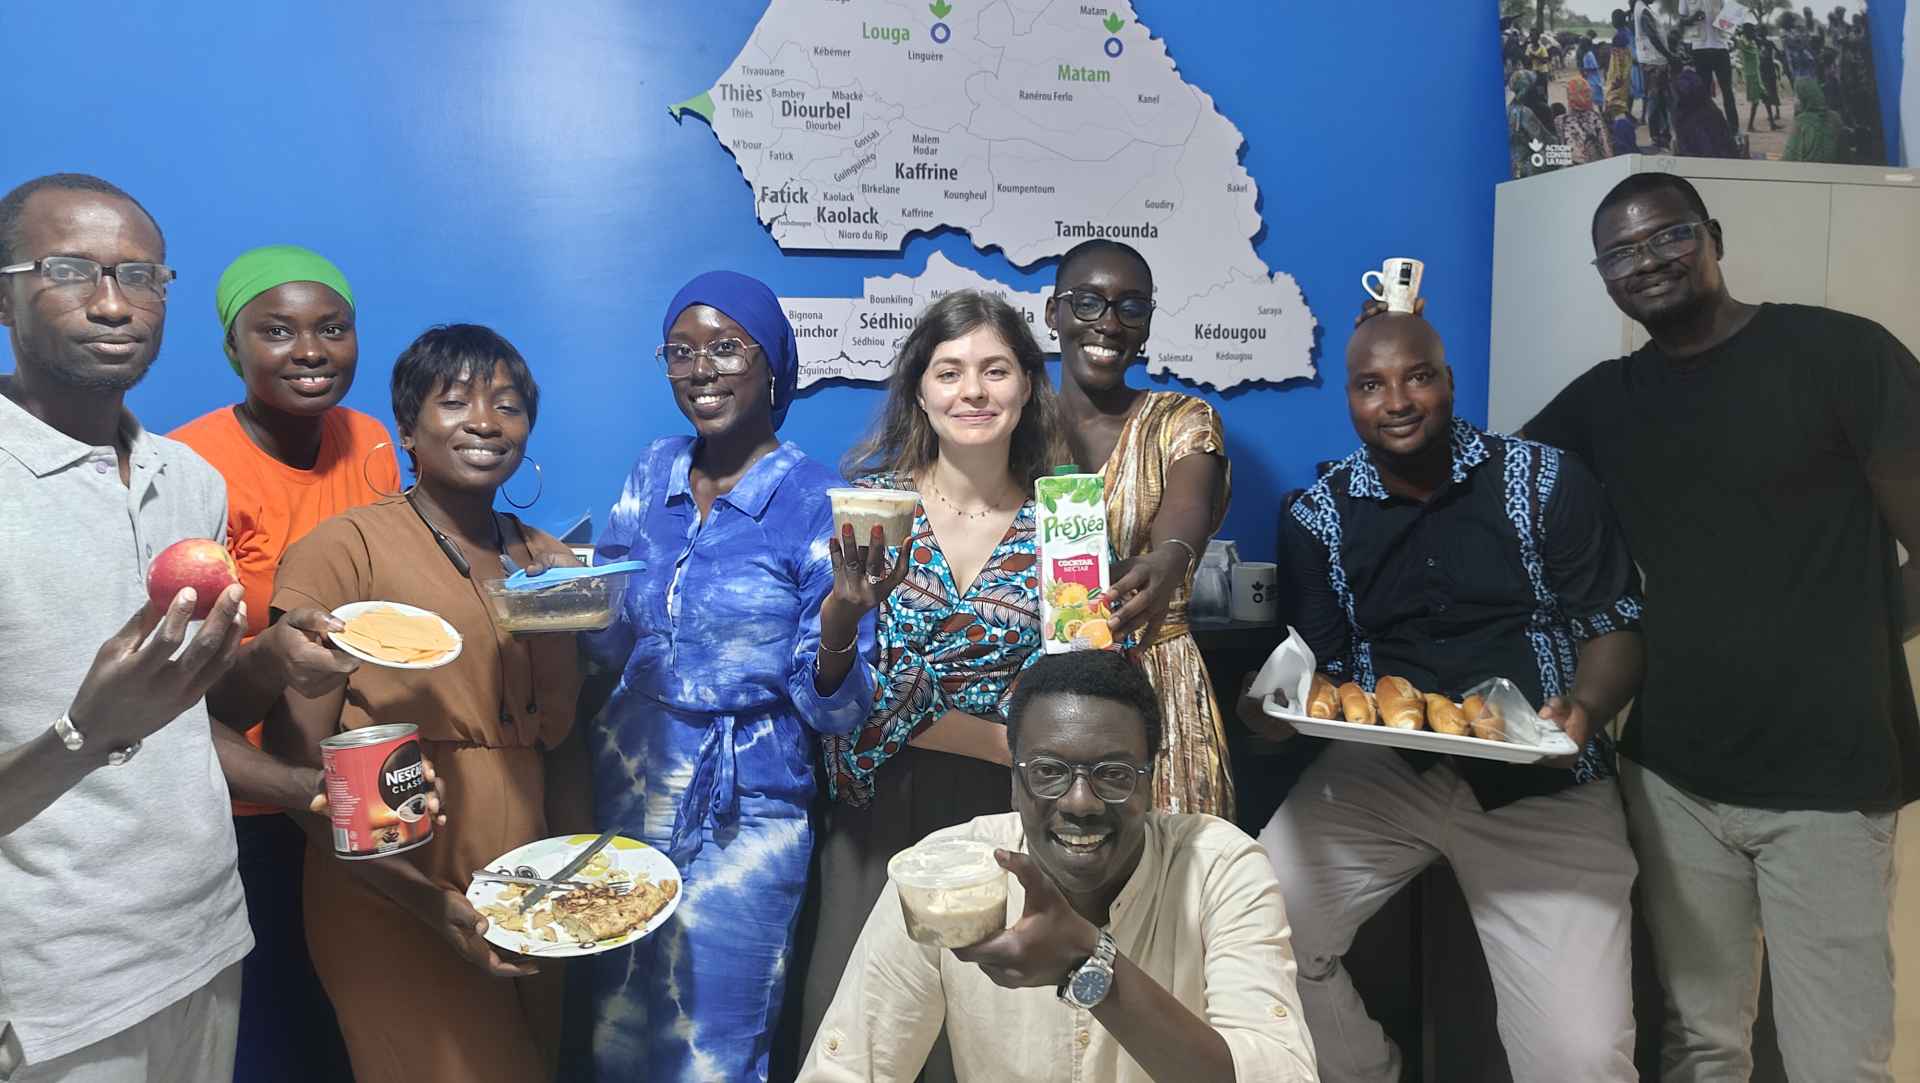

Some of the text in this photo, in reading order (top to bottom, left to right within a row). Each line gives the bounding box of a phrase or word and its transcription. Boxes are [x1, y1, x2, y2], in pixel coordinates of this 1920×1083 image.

[1080, 6, 1107, 16] Matam
[862, 21, 910, 45] Louga
[814, 46, 851, 57] Kébémer
[908, 50, 943, 63] Linguère
[742, 66, 785, 77] Tivaouane
[1058, 64, 1110, 82] Matam
[720, 84, 762, 102] Thiès
[771, 88, 805, 100] Bambey
[1053, 92, 1073, 102] Ferlo
[1138, 94, 1160, 104] Kanel
[732, 107, 753, 118] Thiès
[782, 100, 850, 119] Diourbel
[805, 120, 841, 131] Diourbel
[854, 129, 880, 148] Gossas
[912, 134, 940, 144] Malem
[769, 151, 793, 161] Fatick
[913, 145, 938, 155] Hodar
[895, 162, 958, 181] Kaffrine
[861, 184, 900, 194] Birkelane
[997, 183, 1055, 195] Koumpentoum
[1227, 183, 1248, 193] Bakel
[761, 186, 809, 204] Fatick
[823, 191, 855, 202] Kaolack
[944, 189, 987, 202] Koungheul
[1145, 200, 1174, 212] Goudiry
[816, 206, 880, 224] Kaolack
[901, 207, 934, 218] Kaffrine
[1055, 220, 1158, 239] Tambacounda
[838, 230, 888, 242] Nioro du Rip
[869, 293, 914, 306] Bounkiling
[788, 309, 823, 322] Bignona
[1257, 305, 1283, 316] Saraya
[1195, 323, 1266, 343] Kédougou
[851, 336, 885, 347] Sédhiou
[1158, 352, 1193, 363] Salémata
[1216, 350, 1252, 362] Kédougou
[799, 365, 842, 376] Ziguinchor
